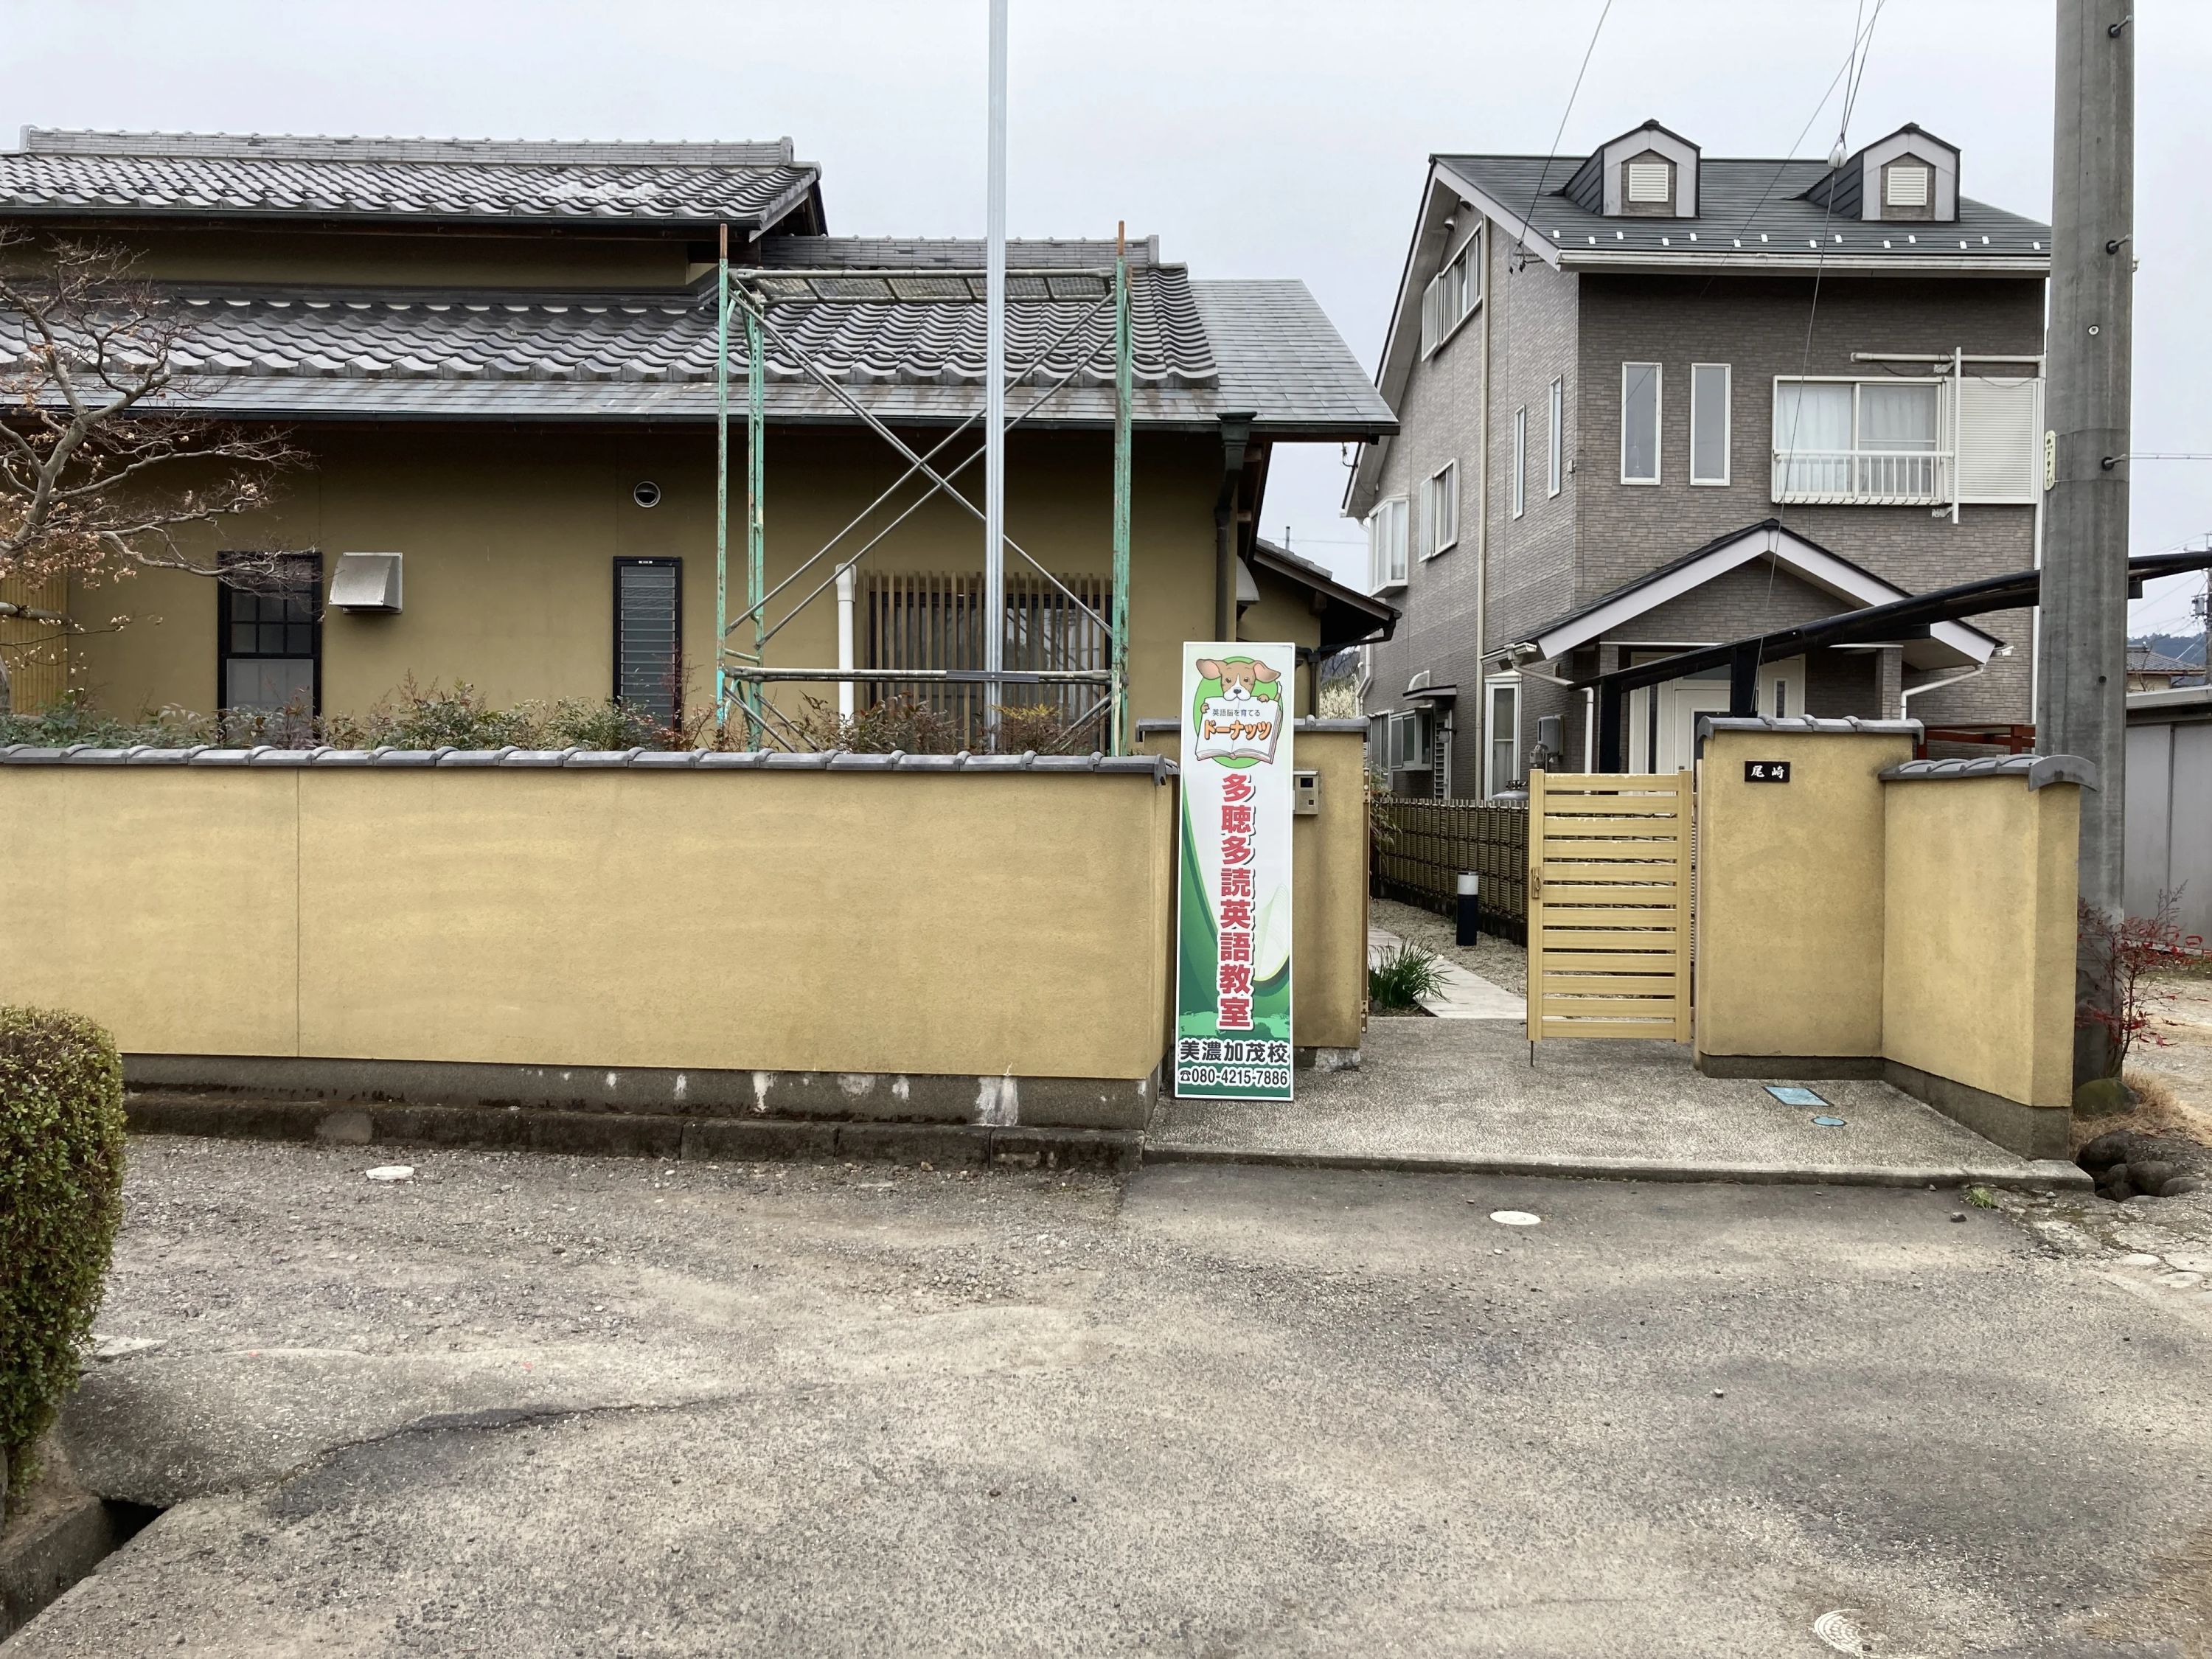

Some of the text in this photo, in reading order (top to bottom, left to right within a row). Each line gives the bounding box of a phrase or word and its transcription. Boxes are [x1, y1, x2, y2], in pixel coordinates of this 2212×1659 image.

[1212, 709, 1261, 717] 英語脳を育てる
[1204, 719, 1273, 741] ドーナッツ
[1220, 773, 1253, 1028] 多聴多読英語教室
[1180, 1040, 1288, 1063] 美濃加茂校
[1192, 1068, 1288, 1085] 080-4215-7886
